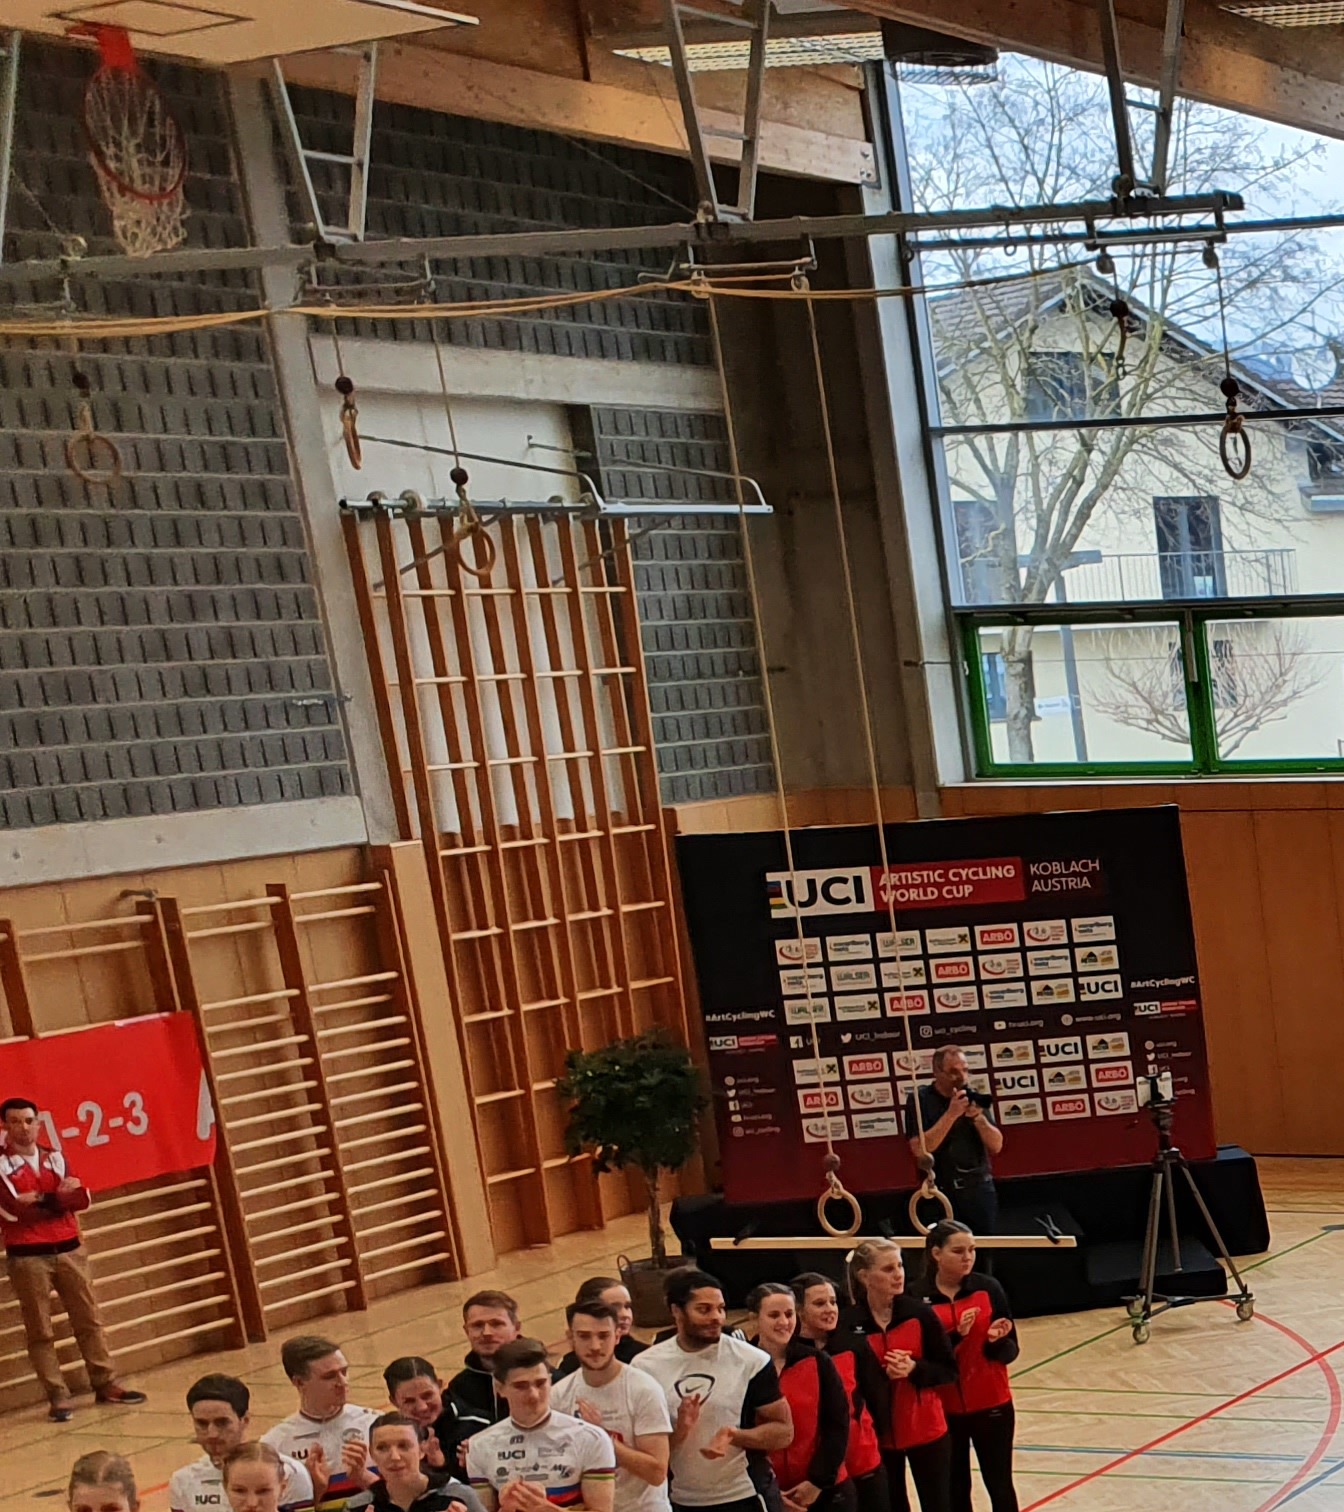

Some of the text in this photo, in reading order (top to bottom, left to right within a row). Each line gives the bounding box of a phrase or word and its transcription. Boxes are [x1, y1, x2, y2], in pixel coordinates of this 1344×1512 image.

[879, 864, 1016, 886] ARTISTIC CYCLING
[1030, 858, 1101, 876] KOBLACH
[786, 874, 866, 909] UCI
[1031, 876, 1092, 893] AUSTRIA
[880, 884, 974, 903] WORLD CUP
[1086, 980, 1119, 995] UCI
[1046, 1042, 1079, 1057] UCI
[1002, 1075, 1036, 1090] UCI
[806, 1093, 837, 1106] ARÖ
[503, 1449, 526, 1461] UCI
